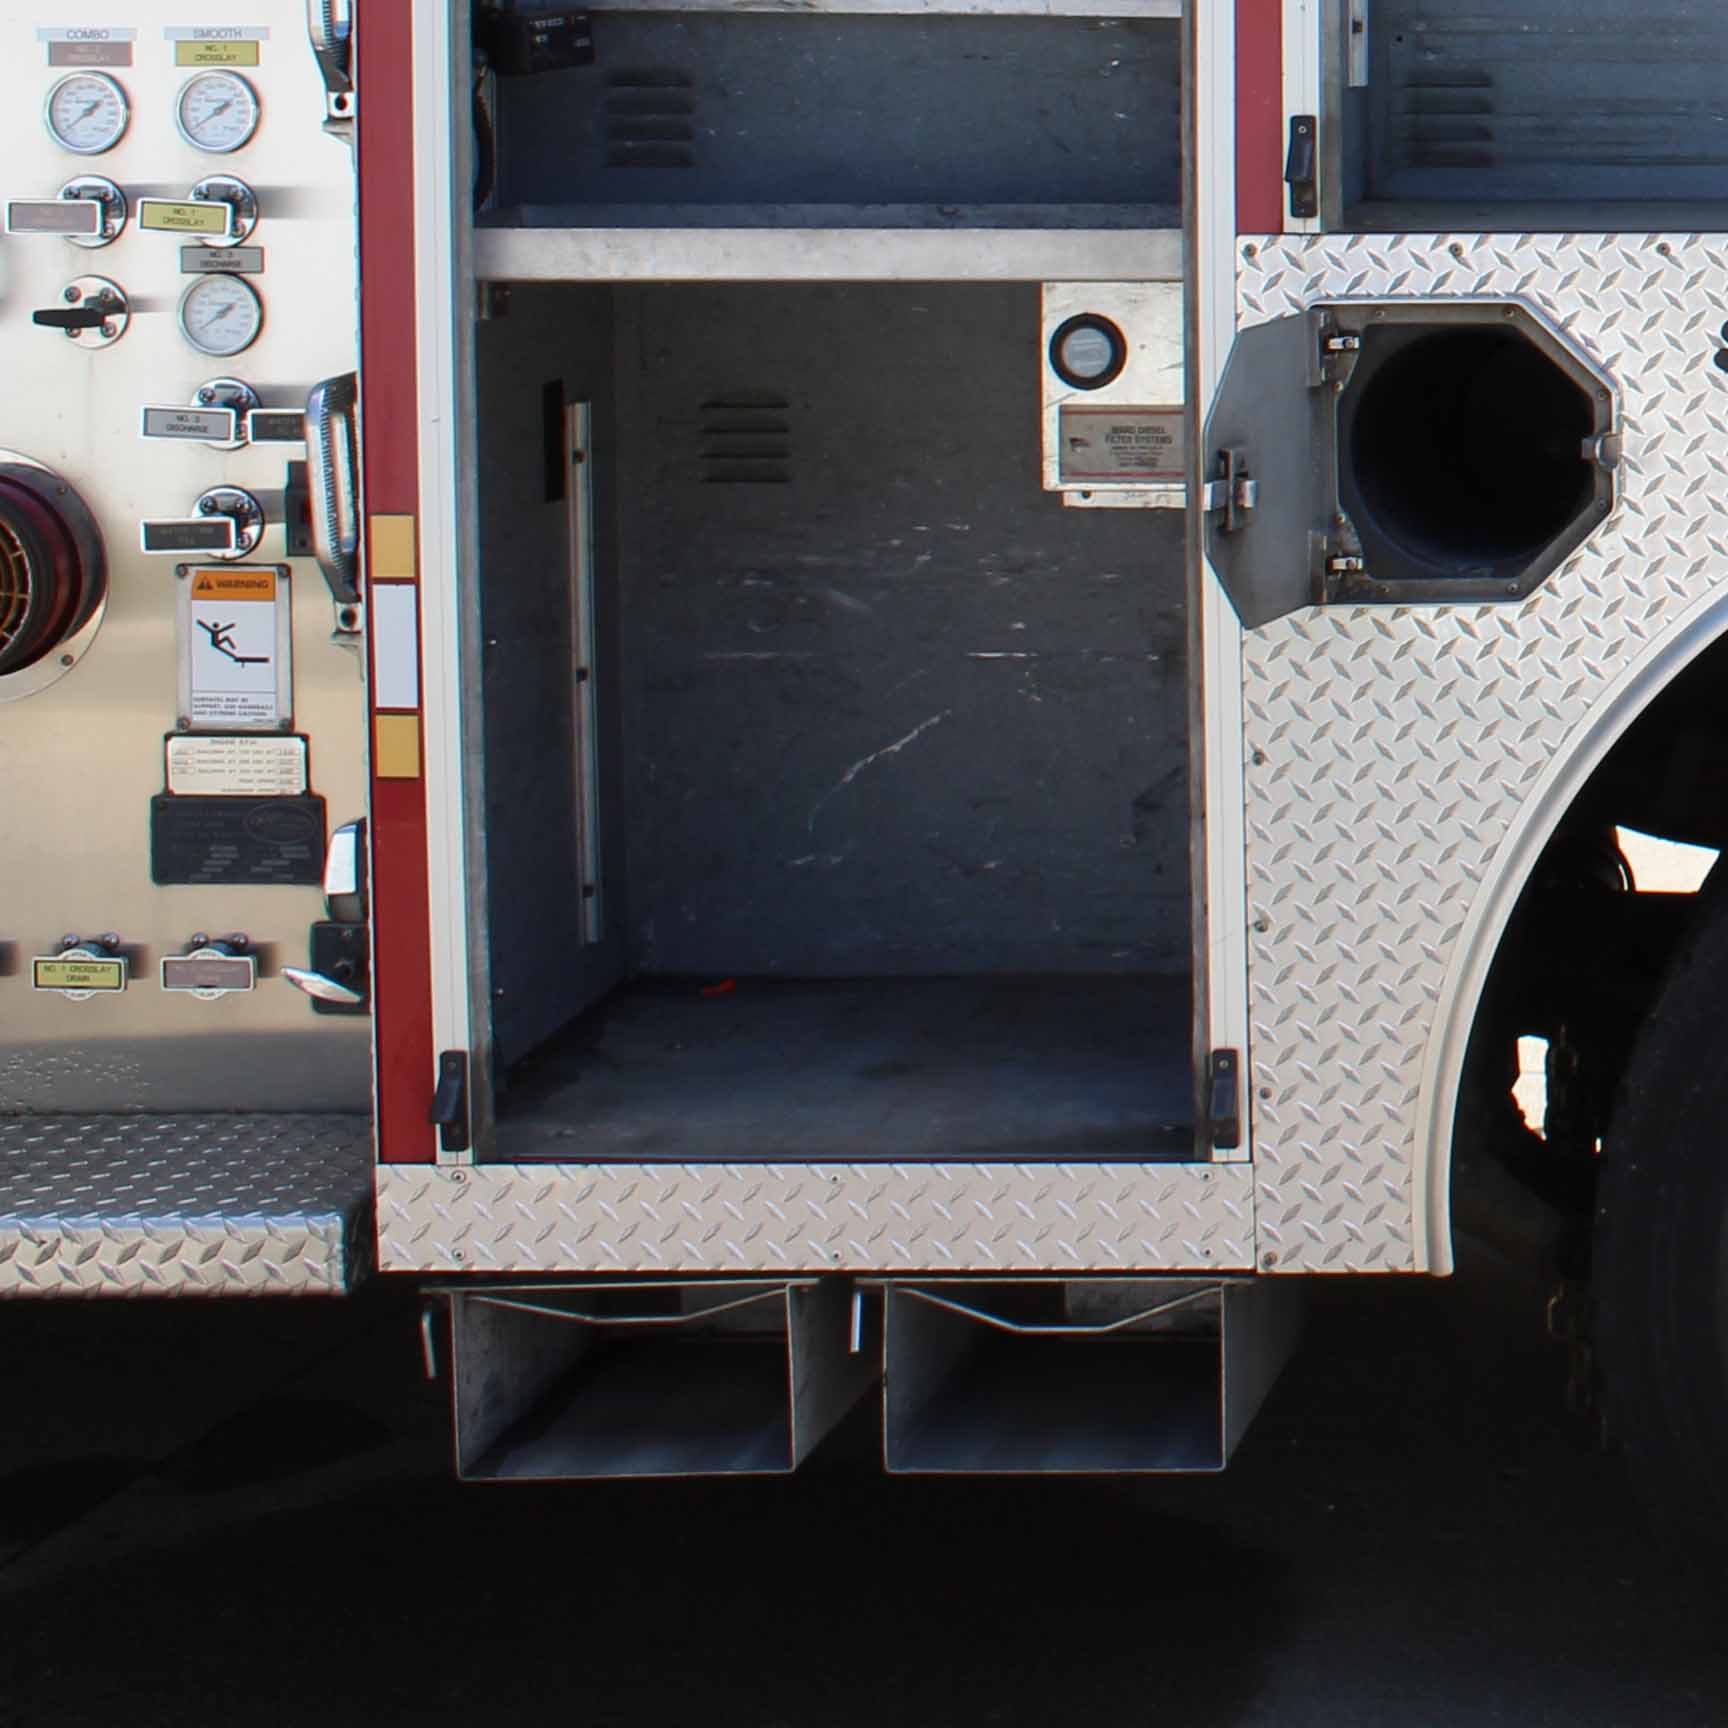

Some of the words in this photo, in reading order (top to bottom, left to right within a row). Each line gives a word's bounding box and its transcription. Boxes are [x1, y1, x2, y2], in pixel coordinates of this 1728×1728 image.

[66, 29, 109, 40] COMBO
[193, 28, 242, 38] SMOOTH
[217, 579, 269, 589] WARNING
